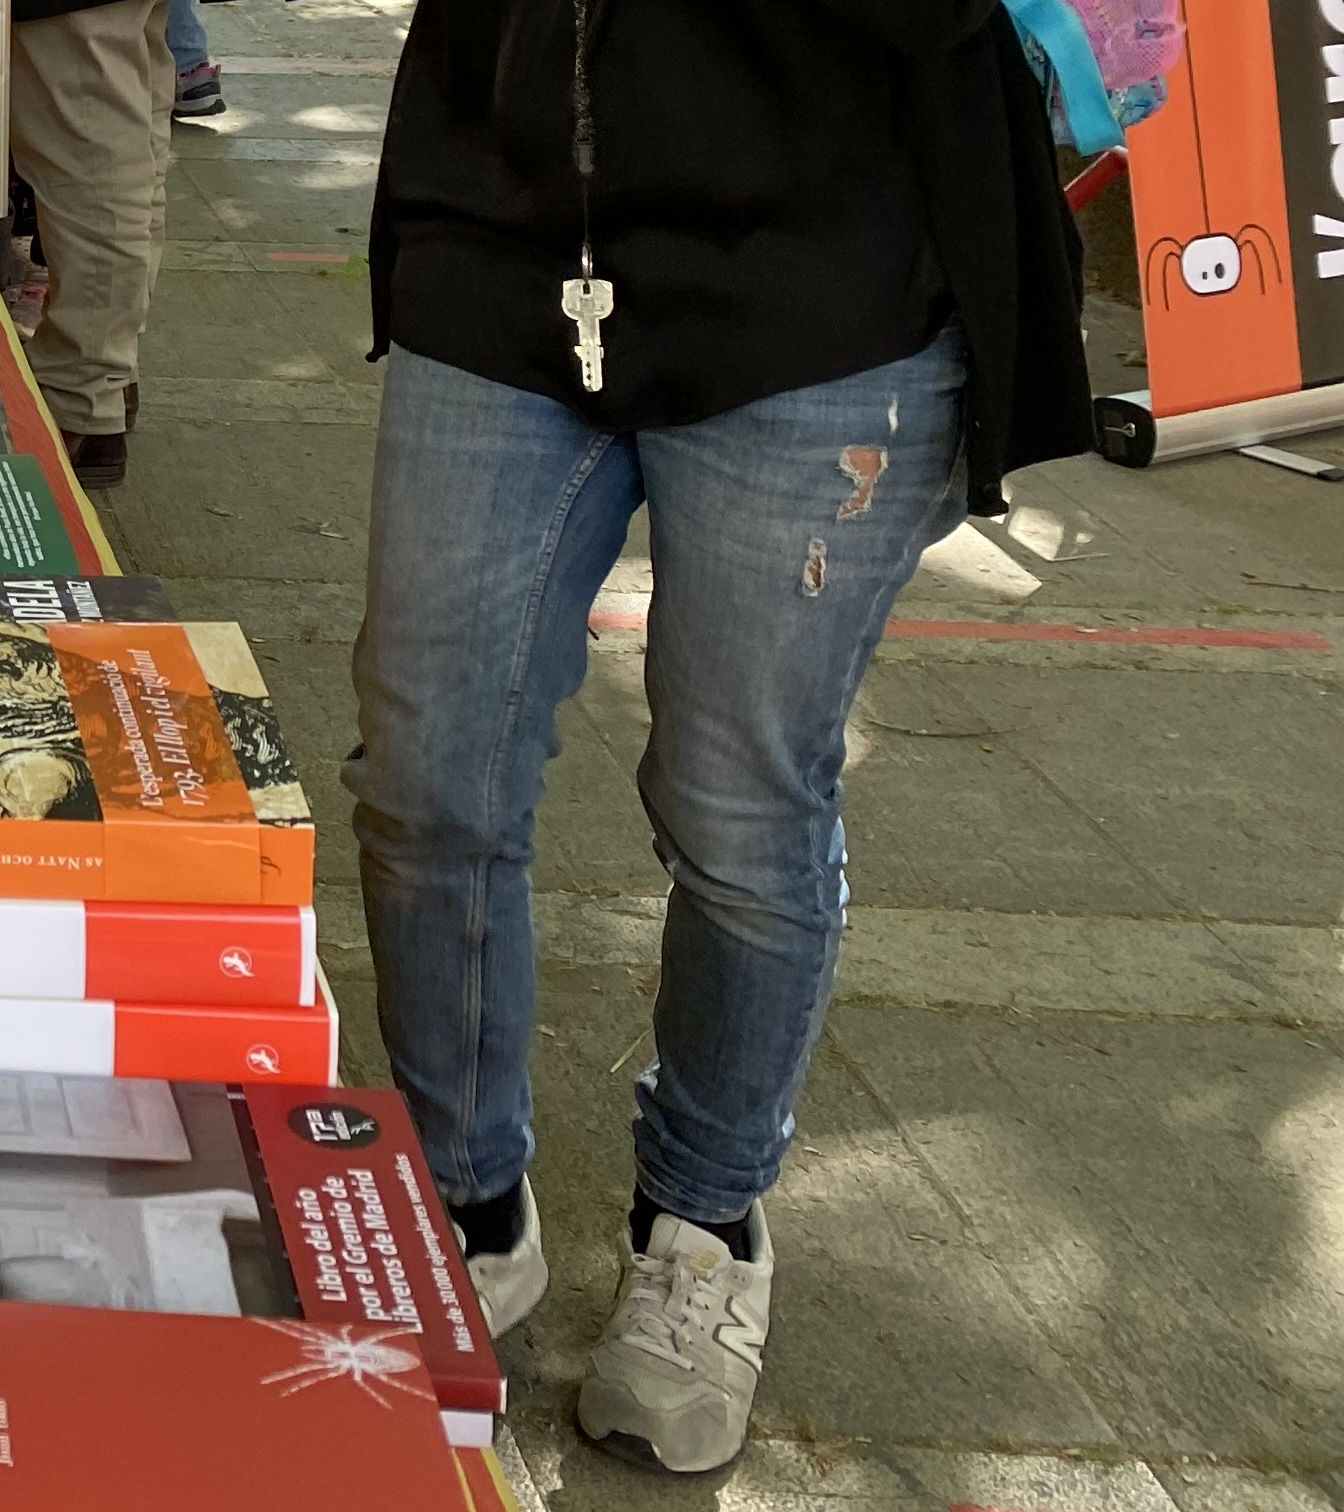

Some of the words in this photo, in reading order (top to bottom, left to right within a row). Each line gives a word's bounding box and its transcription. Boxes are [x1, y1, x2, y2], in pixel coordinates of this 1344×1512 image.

[296, 1187, 323, 1222] año
[346, 1167, 390, 1231] Madrid
[303, 1223, 333, 1253] del
[329, 1201, 369, 1266] Gremio
[315, 1254, 348, 1302] Libro
[381, 1256, 424, 1335] Libreros
[358, 1285, 393, 1322] por
